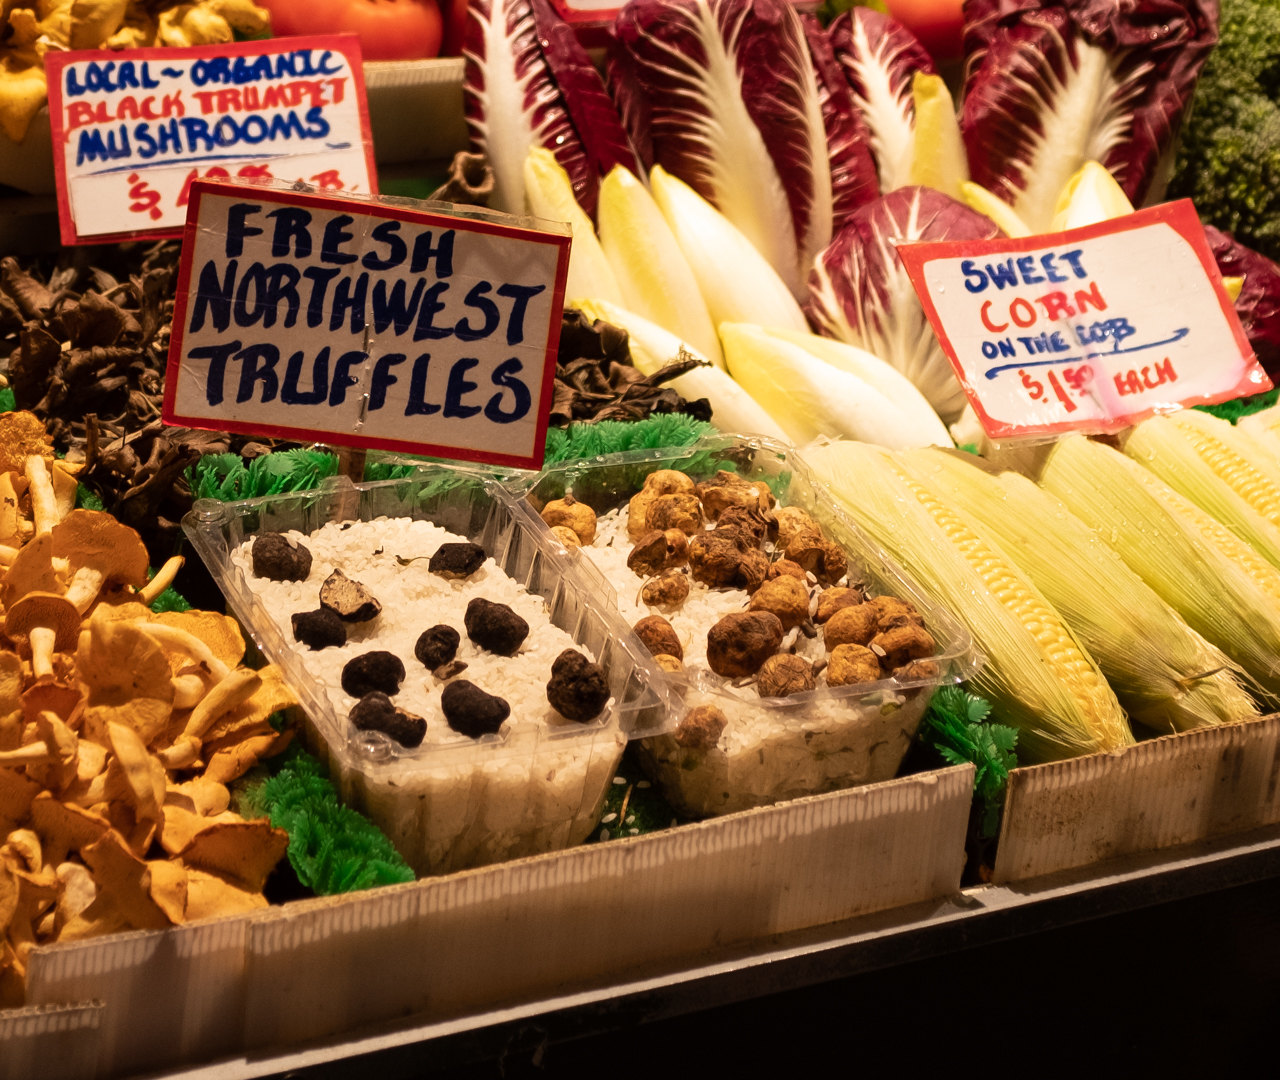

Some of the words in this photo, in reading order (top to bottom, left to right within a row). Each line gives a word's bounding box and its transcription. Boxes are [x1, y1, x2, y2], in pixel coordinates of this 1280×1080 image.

[64, 89, 186, 138] BLACK
[191, 77, 349, 115] TRUMPET
[76, 106, 332, 166] MUSHROOMS
[224, 202, 456, 279] FRESH
[960, 248, 1089, 294] SWEET
[188, 258, 546, 347] NORTHWEST
[980, 281, 1108, 334] CORN
[981, 337, 1016, 360] ON
[1016, 328, 1072, 356] THE
[186, 339, 532, 425] TRUFFLES
[1113, 357, 1179, 396] EACH
